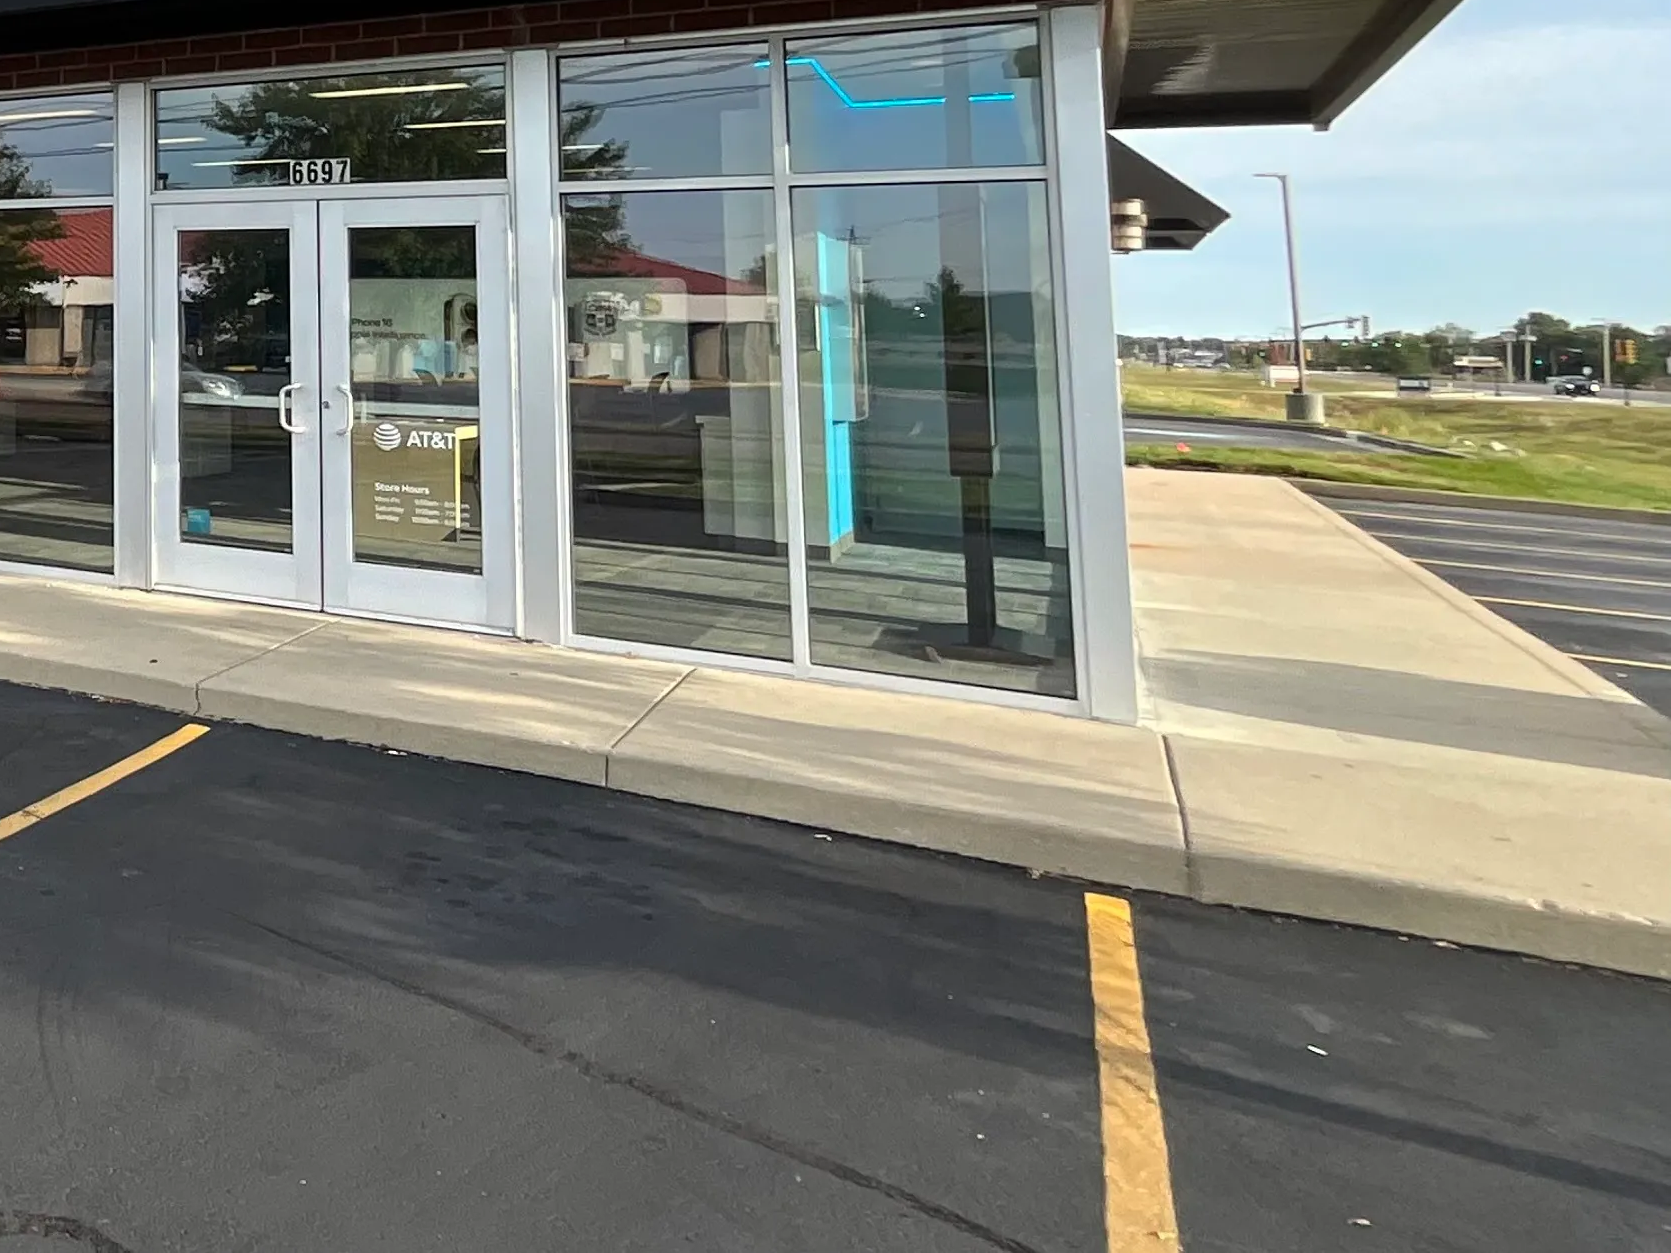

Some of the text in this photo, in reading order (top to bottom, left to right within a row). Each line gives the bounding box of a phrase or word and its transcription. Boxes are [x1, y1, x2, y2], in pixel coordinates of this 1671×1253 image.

[292, 159, 348, 184] 6697
[406, 430, 456, 450] AT&T
[374, 482, 430, 496] Store Hours
